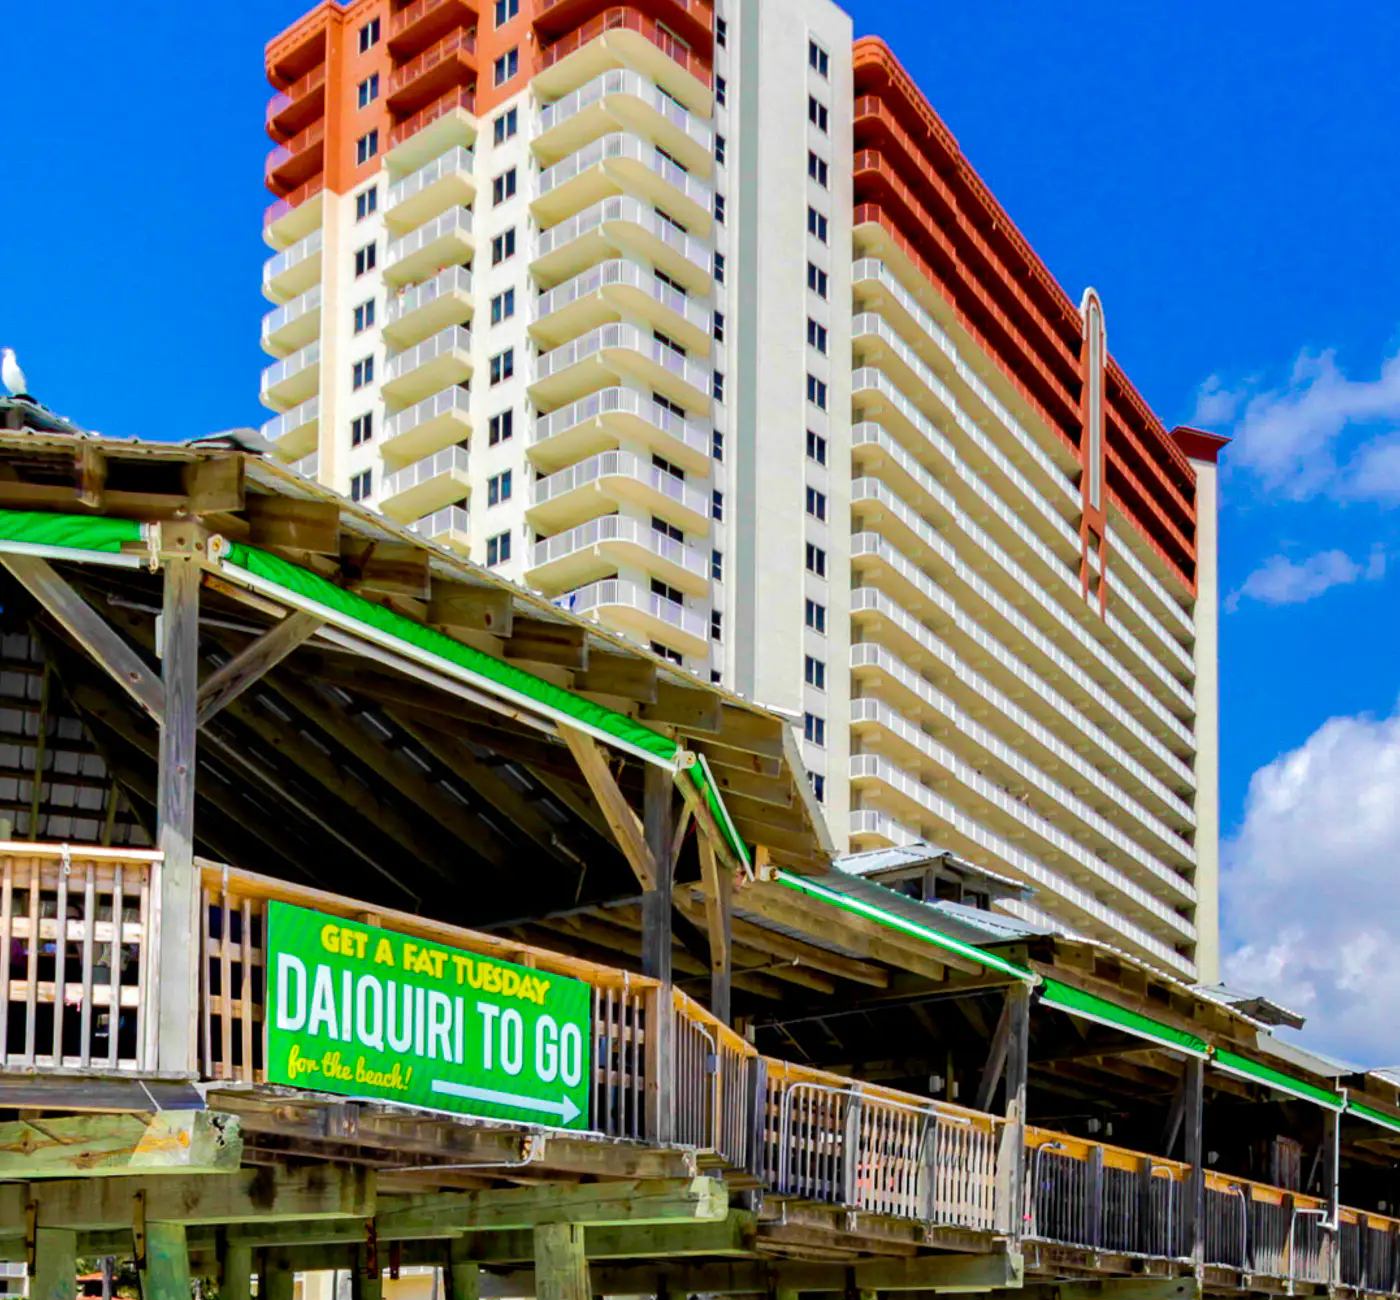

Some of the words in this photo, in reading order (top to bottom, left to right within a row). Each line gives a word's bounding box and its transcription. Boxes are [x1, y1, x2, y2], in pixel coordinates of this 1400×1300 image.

[320, 924, 368, 959] GET
[374, 938, 394, 966] A
[403, 943, 448, 979] FAT
[452, 955, 550, 1005] TUESDAY
[277, 952, 464, 1065] DAIQUIRI
[476, 1001, 524, 1075] TO
[535, 1015, 582, 1087] GO
[287, 1044, 319, 1079] for
[321, 1052, 353, 1080] the
[356, 1056, 413, 1090] beach!
